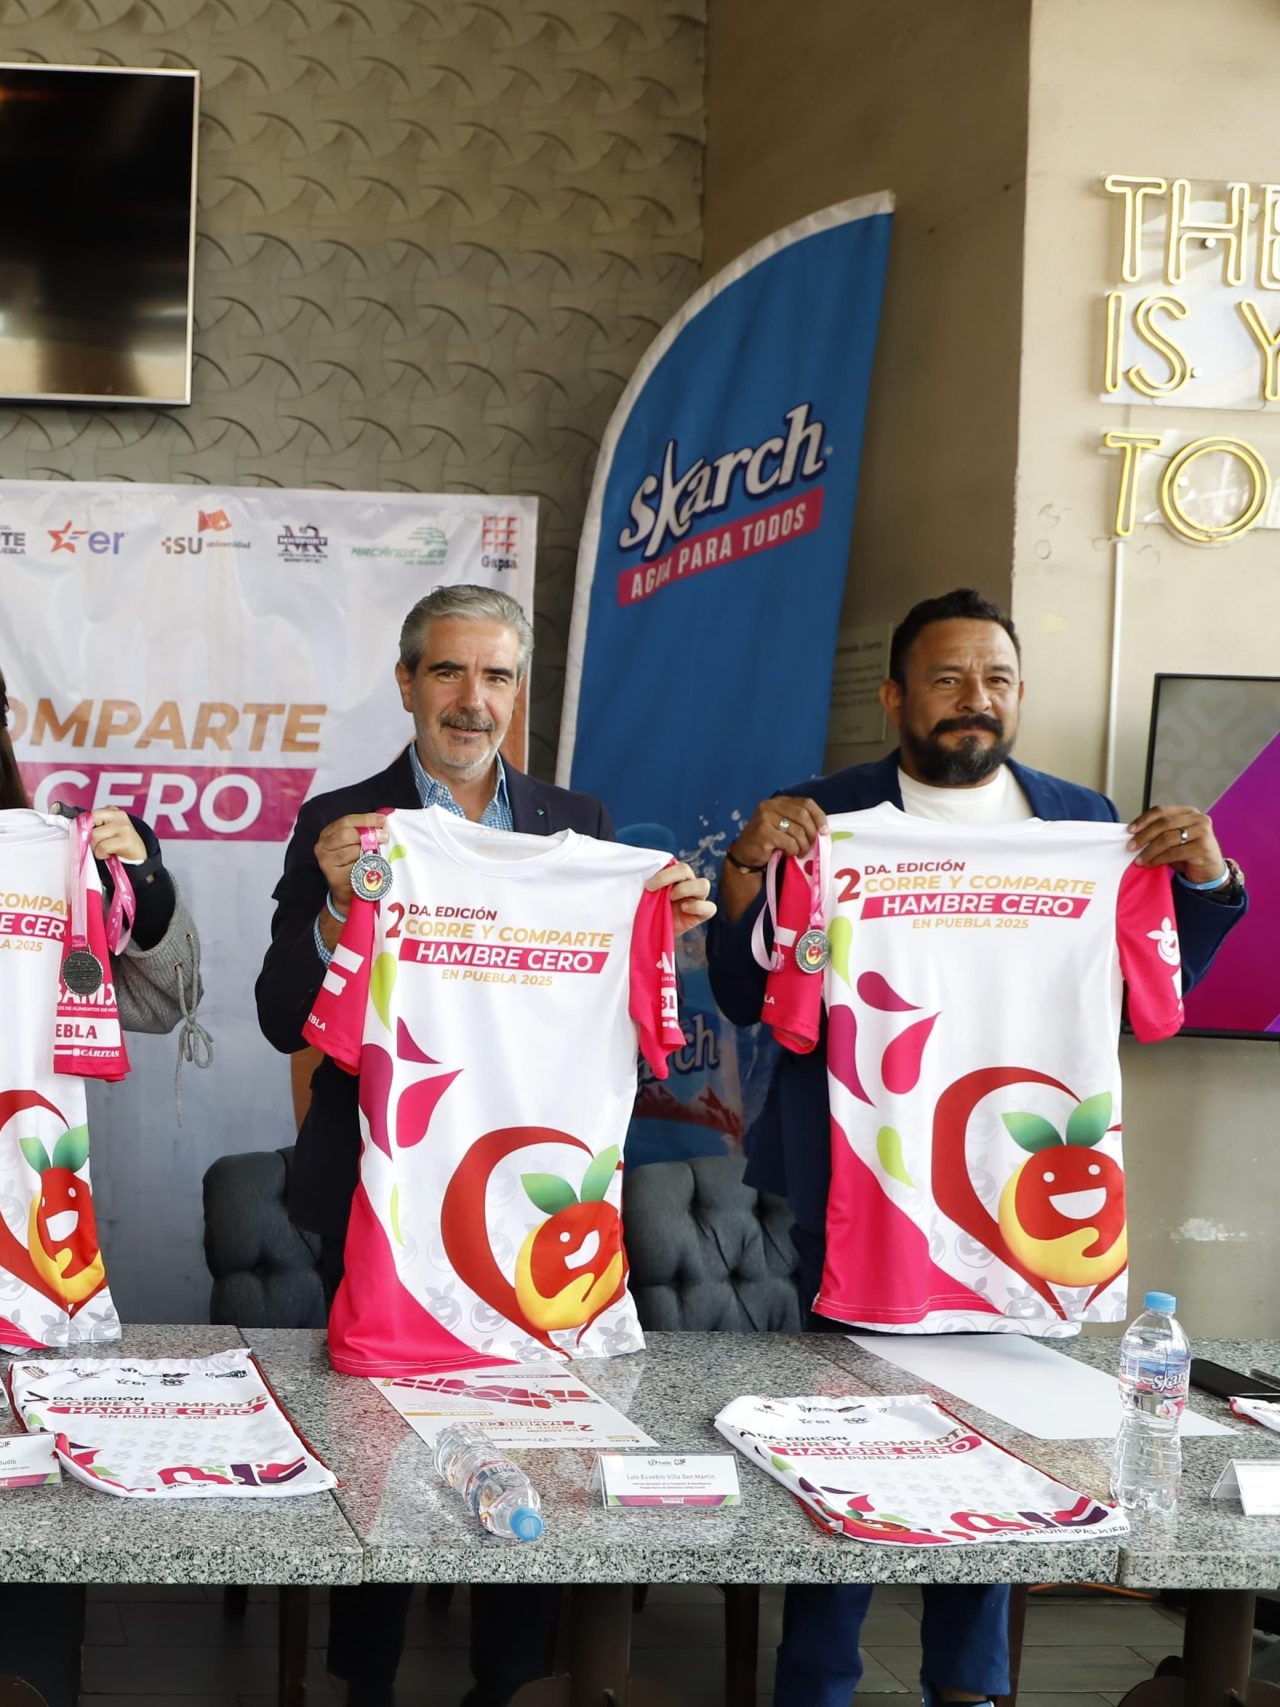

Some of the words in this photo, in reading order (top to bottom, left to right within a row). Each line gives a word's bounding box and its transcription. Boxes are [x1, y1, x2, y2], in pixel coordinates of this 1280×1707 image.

[619, 402, 825, 559] Skarch
[88, 531, 125, 555] er
[631, 557, 672, 599] AGUA
[678, 532, 732, 574] PARA
[742, 503, 806, 551] TODOS
[481, 556, 518, 572] Gapsa
[7, 696, 327, 752] MPARTE
[34, 770, 263, 833] CERO
[834, 867, 861, 904] 2
[864, 865, 891, 875] DA.
[896, 859, 966, 873] EDICIÓN
[864, 875, 941, 893] CORRE
[950, 875, 965, 889] Y
[969, 875, 1096, 895] COMPARTE
[883, 895, 993, 916] HAMBRE
[1001, 895, 1074, 916] CERO
[20, 916, 67, 939] CER
[385, 902, 405, 939] 2
[408, 904, 431, 917] DA.
[435, 906, 498, 921] EDICIÓN
[912, 918, 931, 929] EN
[936, 918, 991, 929] PUEBLA
[995, 918, 1029, 930] 2025
[405, 919, 476, 939] CORRE
[482, 925, 495, 940] Y
[498, 927, 614, 948] COMPARTE
[15, 940, 43, 952] 2025
[416, 943, 523, 968] HAMBRE
[527, 950, 593, 972] CERO
[442, 969, 459, 980] EN
[462, 971, 517, 984] PUEBLA
[522, 974, 553, 986] 2025
[56, 1023, 98, 1039] EBLA
[81, 1048, 119, 1058] CÁRITAS
[52, 1400, 132, 1408] CORRE
[153, 1394, 268, 1408] COMPARTE
[69, 1407, 179, 1415] HAMBRE
[187, 1408, 255, 1416] CERO
[786, 1447, 894, 1456] HAMBRE
[902, 1441, 971, 1456] CERO
